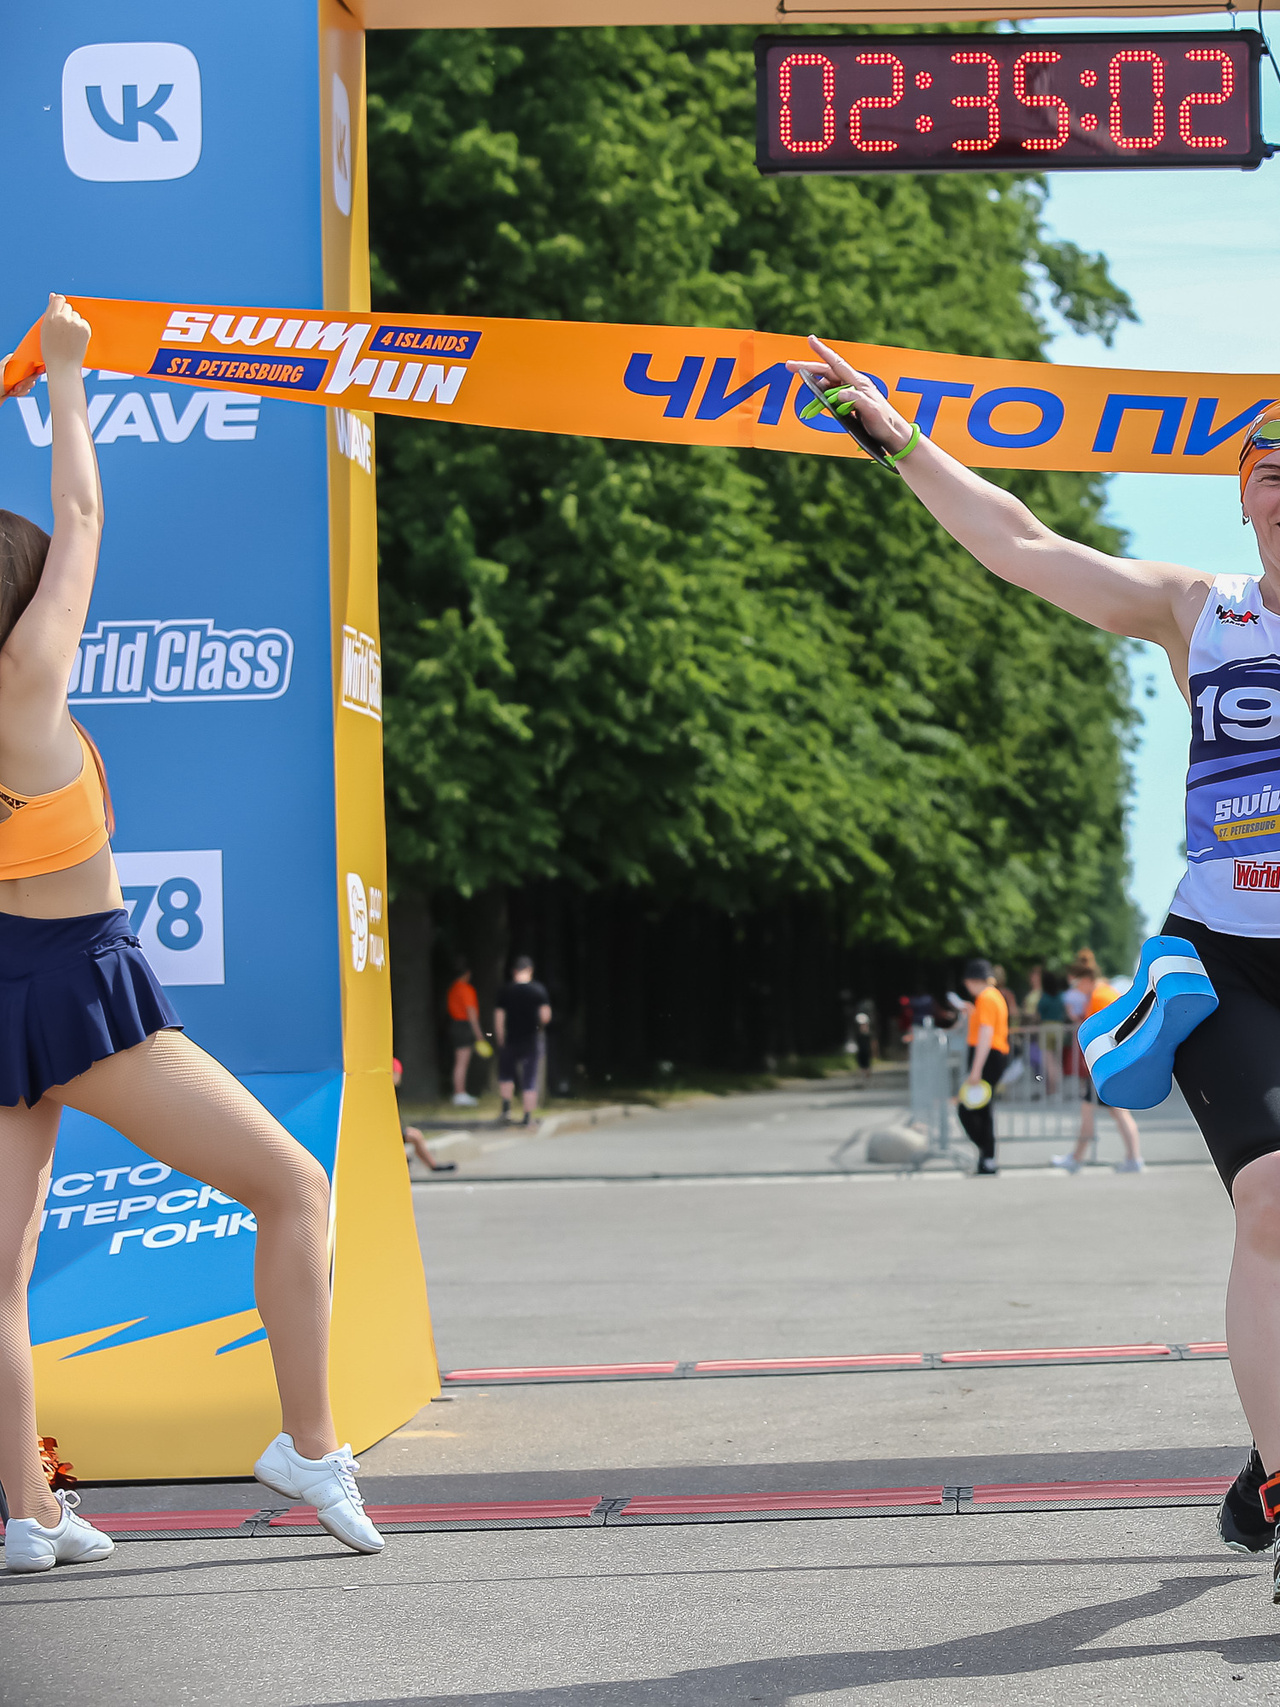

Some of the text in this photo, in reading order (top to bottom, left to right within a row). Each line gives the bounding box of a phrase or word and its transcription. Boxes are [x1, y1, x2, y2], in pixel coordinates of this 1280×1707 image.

[778, 49, 1235, 153] 02:35:02
[380, 331, 470, 353] 4 ISLANDS
[166, 357, 305, 384] ST. PETERSBURG
[154, 630, 284, 691] Class
[1230, 819, 1276, 836] PETERSBURG
[1236, 863, 1280, 889] World
